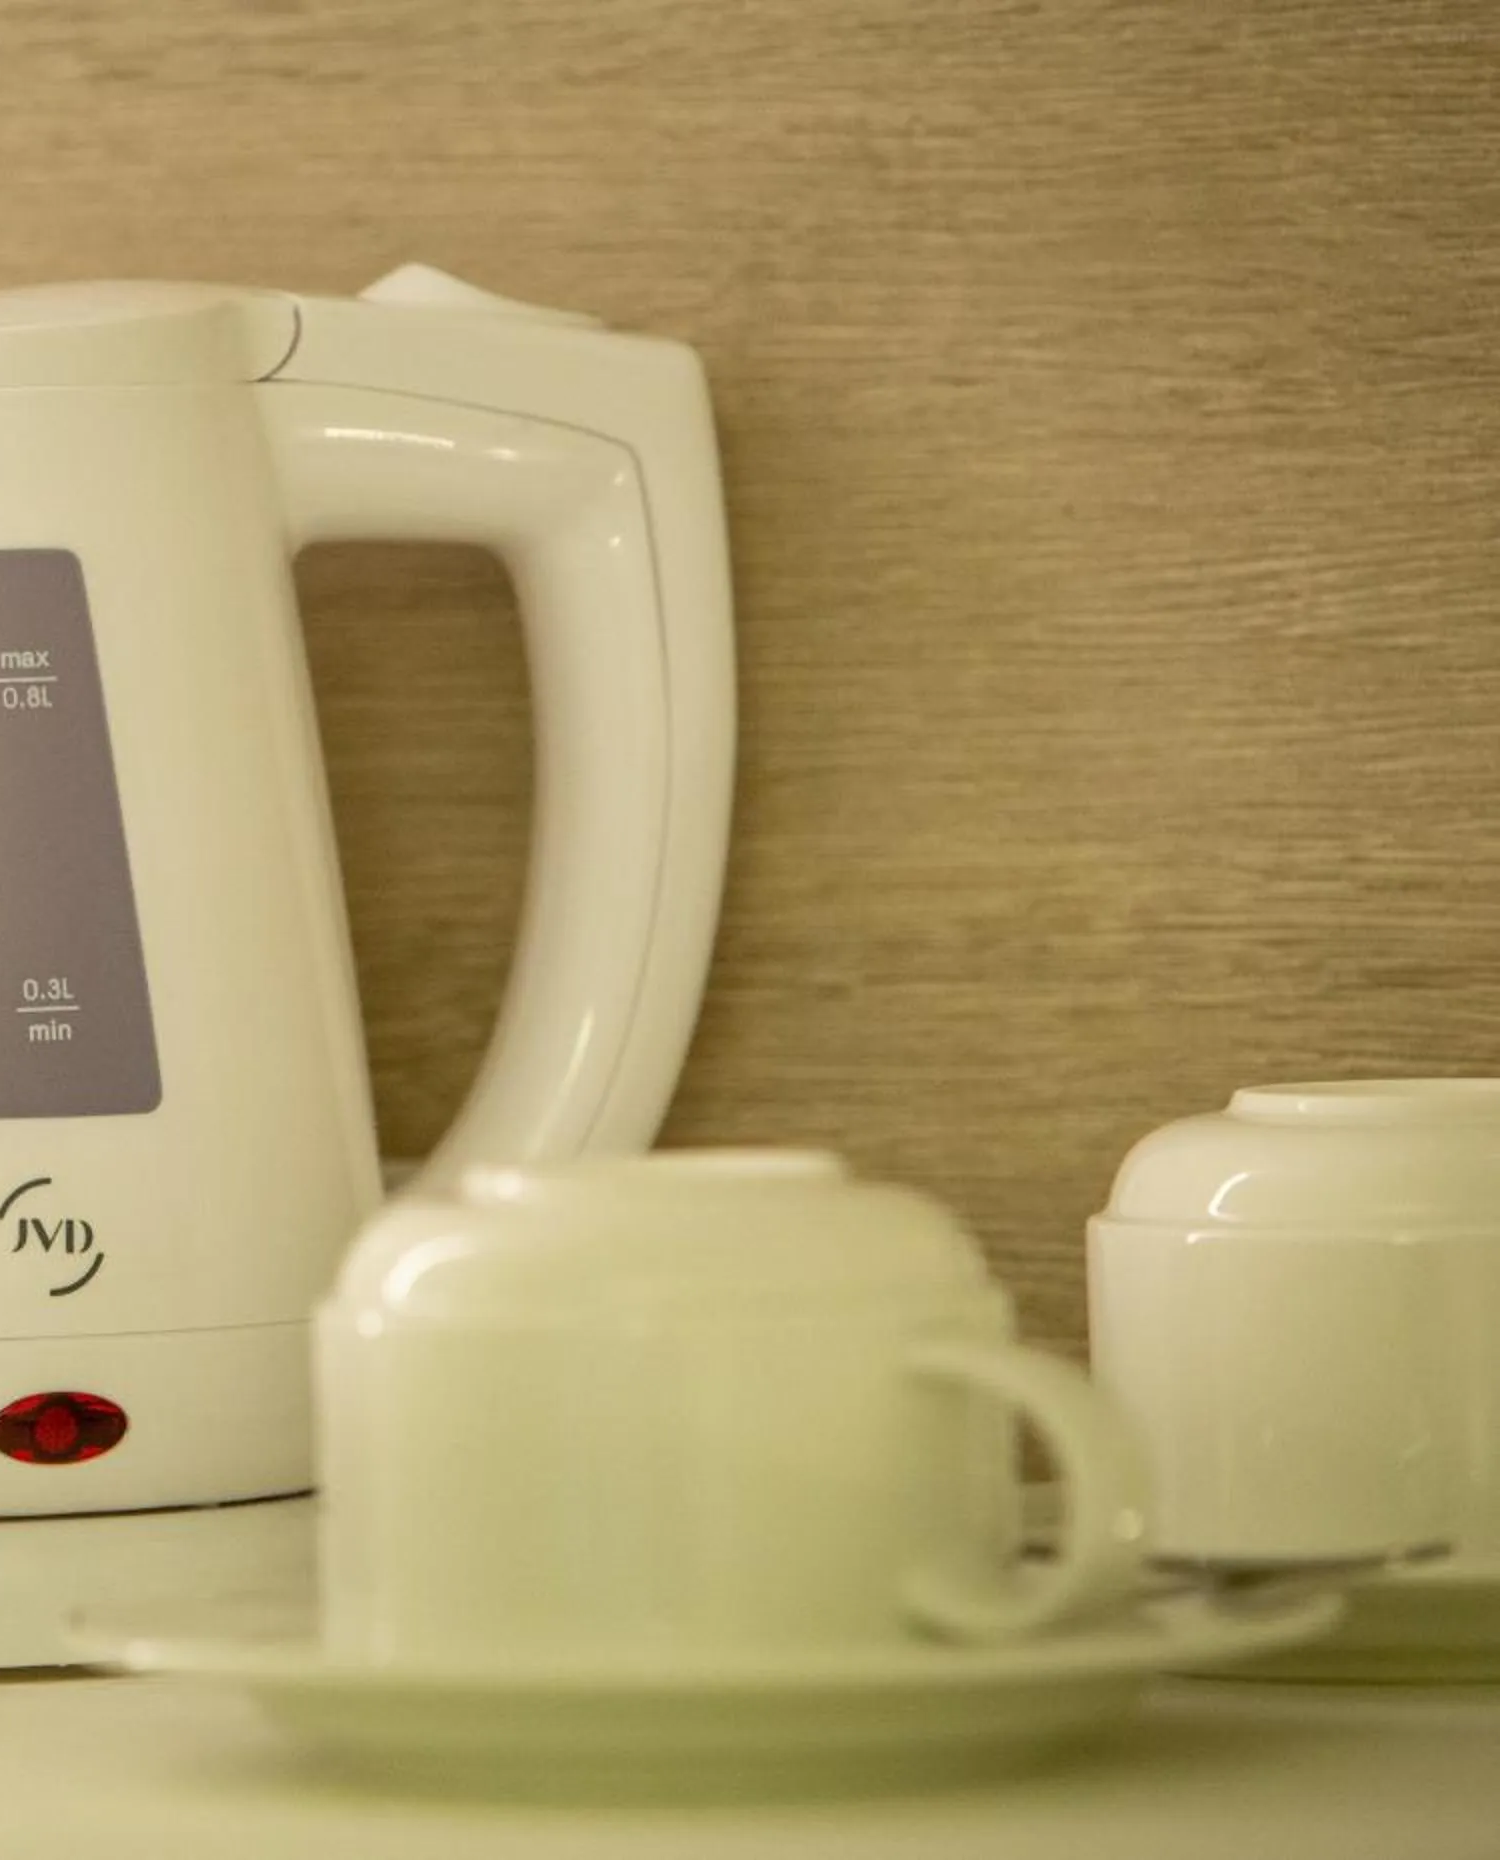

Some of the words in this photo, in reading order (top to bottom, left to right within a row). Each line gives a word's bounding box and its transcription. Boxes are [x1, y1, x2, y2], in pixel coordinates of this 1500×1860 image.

[0, 649, 50, 668] max
[3, 685, 53, 709] 0.8L
[22, 978, 75, 1001] 0.3L
[28, 1019, 72, 1041] min
[11, 1217, 95, 1254] JVD
